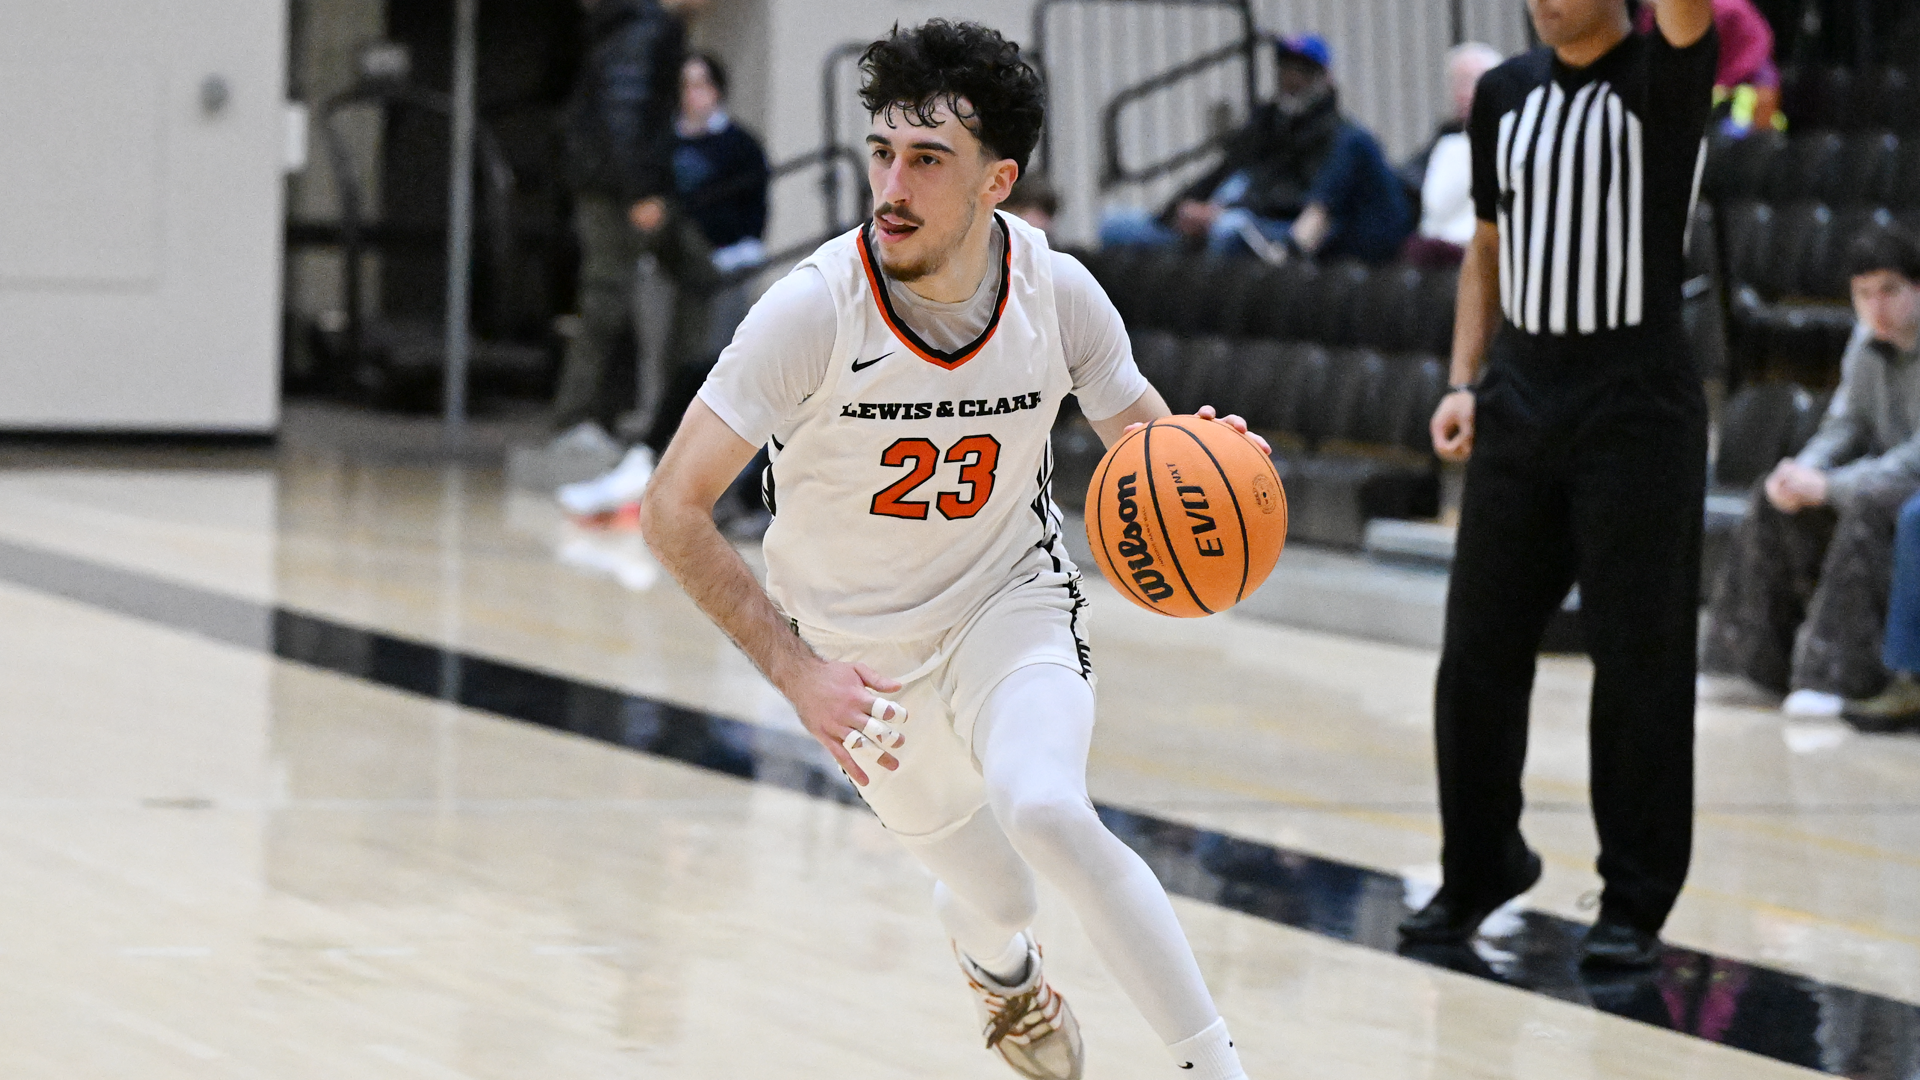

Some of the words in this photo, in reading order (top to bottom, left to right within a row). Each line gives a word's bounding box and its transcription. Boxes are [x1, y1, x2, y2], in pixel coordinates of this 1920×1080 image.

[840, 402, 933, 420] LEWIS
[936, 400, 955, 418] &
[869, 433, 1002, 521] 23
[1166, 462, 1183, 484] NXT
[1117, 471, 1174, 604] Wilson
[1176, 485, 1225, 557] EVO
